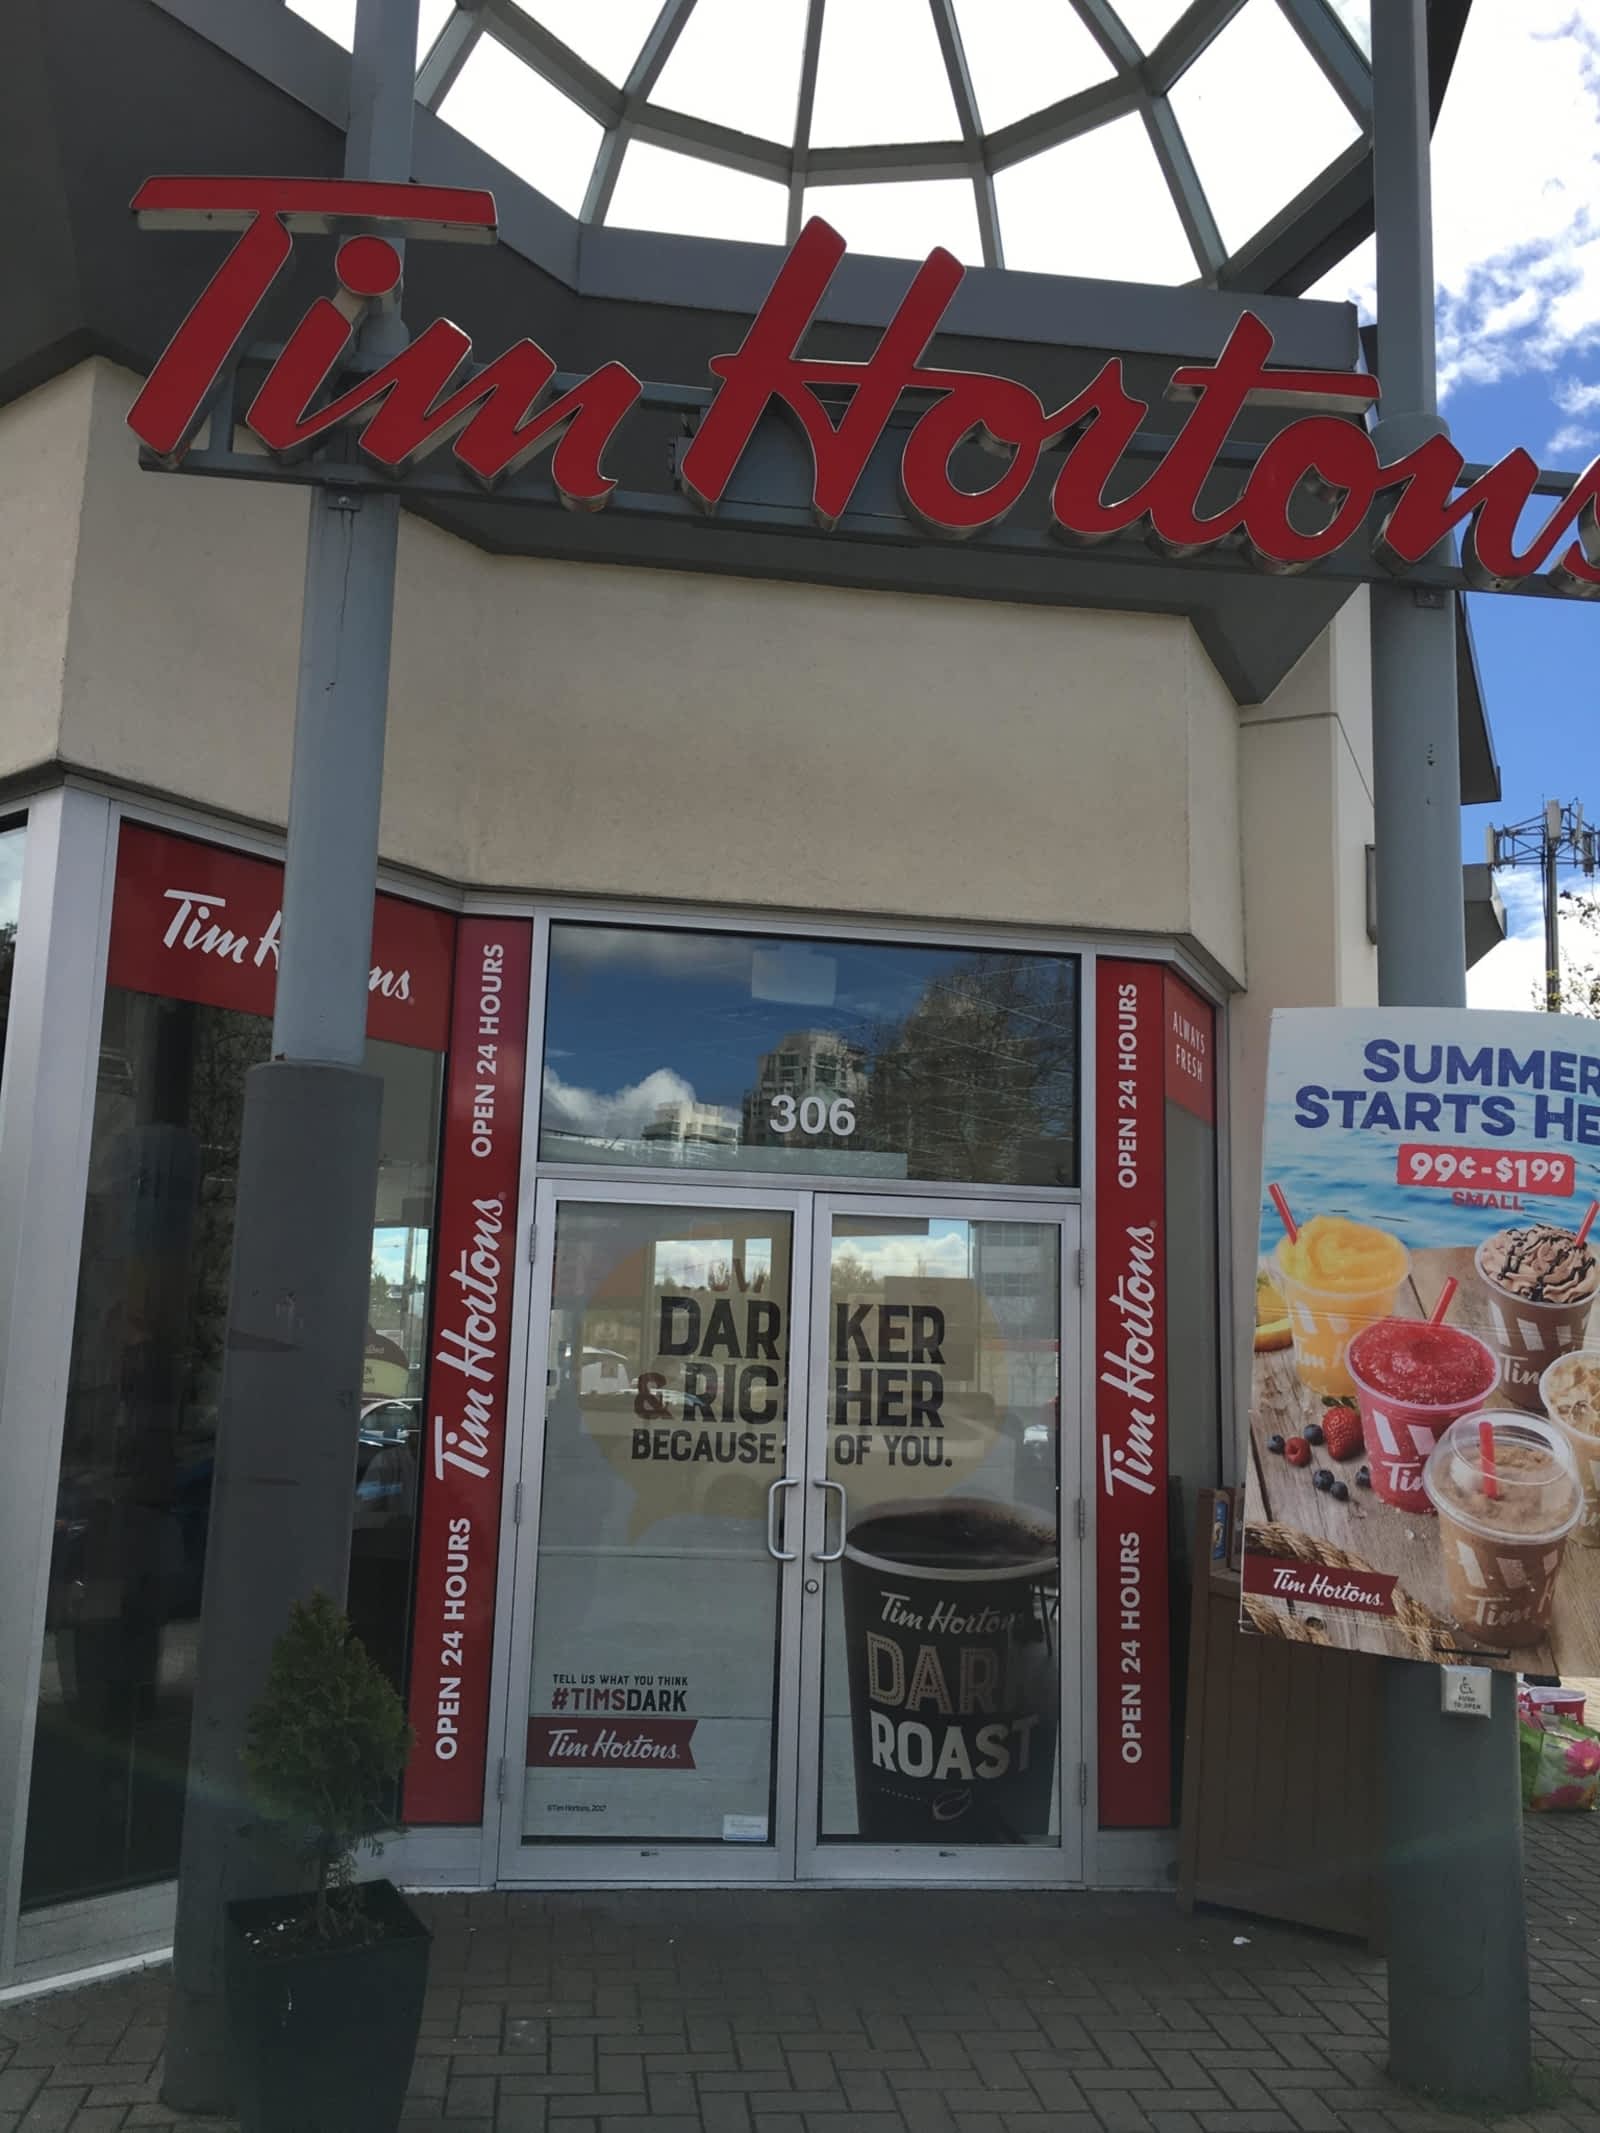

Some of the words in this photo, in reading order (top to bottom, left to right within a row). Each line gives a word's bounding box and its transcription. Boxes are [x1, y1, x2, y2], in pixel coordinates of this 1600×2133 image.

[126, 176, 644, 503] Tim
[163, 889, 249, 963] Tim
[479, 944, 504, 1035] HOURS
[477, 1044, 497, 1074] 24
[1118, 983, 1137, 1071] HOURS
[1172, 1011, 1205, 1054] ALWAYS
[1118, 1079, 1137, 1109] 24
[1175, 1044, 1203, 1082] FRESH
[471, 1084, 496, 1158] OPEN
[769, 1094, 857, 1136] 306
[1294, 1084, 1516, 1138] STARTS
[1534, 1094, 1600, 1146] HE
[1118, 1118, 1137, 1189] OPEN
[1451, 1190, 1525, 1212] SMALL
[436, 1198, 503, 1383] Hortons
[1100, 1226, 1155, 1403] Hortons
[633, 1371, 673, 1420] &
[434, 1387, 495, 1481] Tim
[631, 1428, 777, 1465] BECAUSE
[834, 1434, 873, 1466] OF
[883, 1434, 954, 1468] YOU.
[1102, 1407, 1156, 1497] Tim
[443, 1517, 471, 1620] HOURS
[1119, 1531, 1141, 1630] HOURS
[1273, 1568, 1306, 1594] Tim
[1308, 1573, 1381, 1606] Hortons
[880, 1590, 923, 1631] Tim
[441, 1630, 464, 1666] 24
[553, 1674, 577, 1684] TELL
[581, 1674, 596, 1684] US
[600, 1675, 629, 1685] WHAT
[634, 1675, 654, 1686] YOU
[659, 1676, 689, 1686] THINK
[866, 1630, 1000, 1715] DAR
[1121, 1639, 1141, 1673] 24
[435, 1676, 462, 1761] OPEN
[551, 1687, 688, 1712] #TIMSDARK
[1120, 1683, 1142, 1765] OPEN
[548, 1729, 589, 1757] Tim
[591, 1728, 677, 1759] Hortons
[869, 1708, 1041, 1782] ROAST
